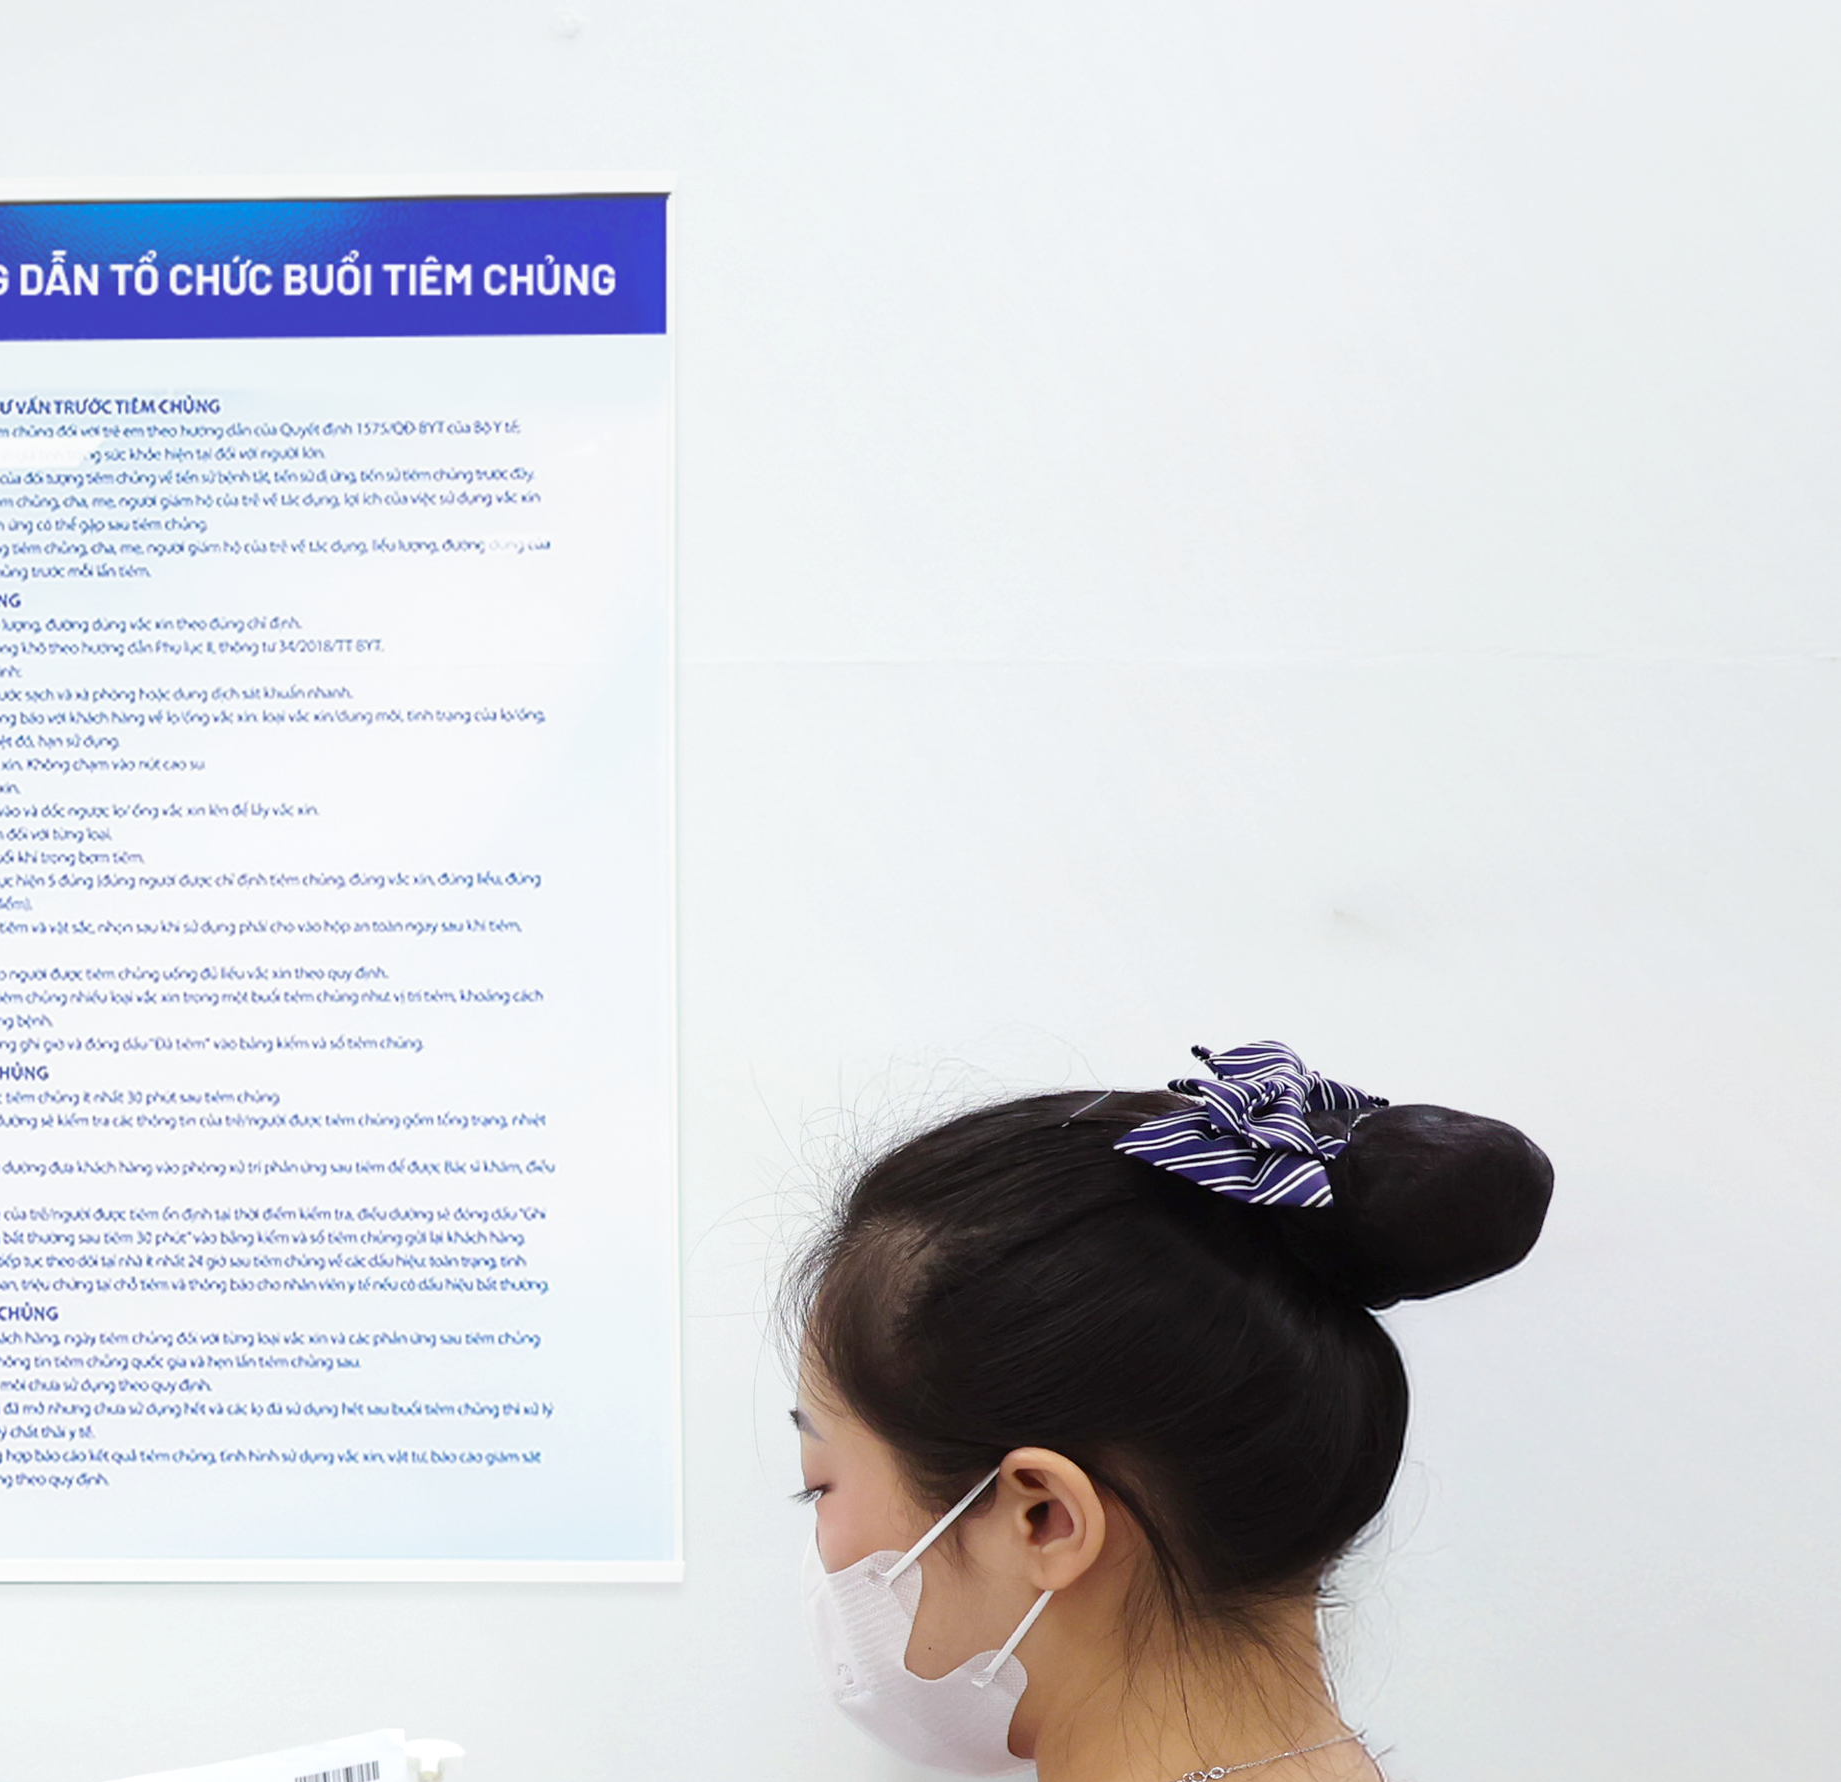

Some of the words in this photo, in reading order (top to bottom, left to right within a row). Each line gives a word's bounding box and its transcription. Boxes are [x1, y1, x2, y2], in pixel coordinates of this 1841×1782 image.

[18, 248, 100, 297] DẪN
[108, 248, 160, 297] TỔ
[168, 254, 274, 297] CHỨC
[282, 248, 373, 297] BUỔI
[380, 254, 474, 297] TIÊM
[482, 253, 617, 297] CHỦNG
[15, 395, 52, 415] VẤN
[53, 397, 113, 415] TRƯỚC
[114, 396, 157, 415] TIÊM
[157, 394, 221, 415] CHỦNG
